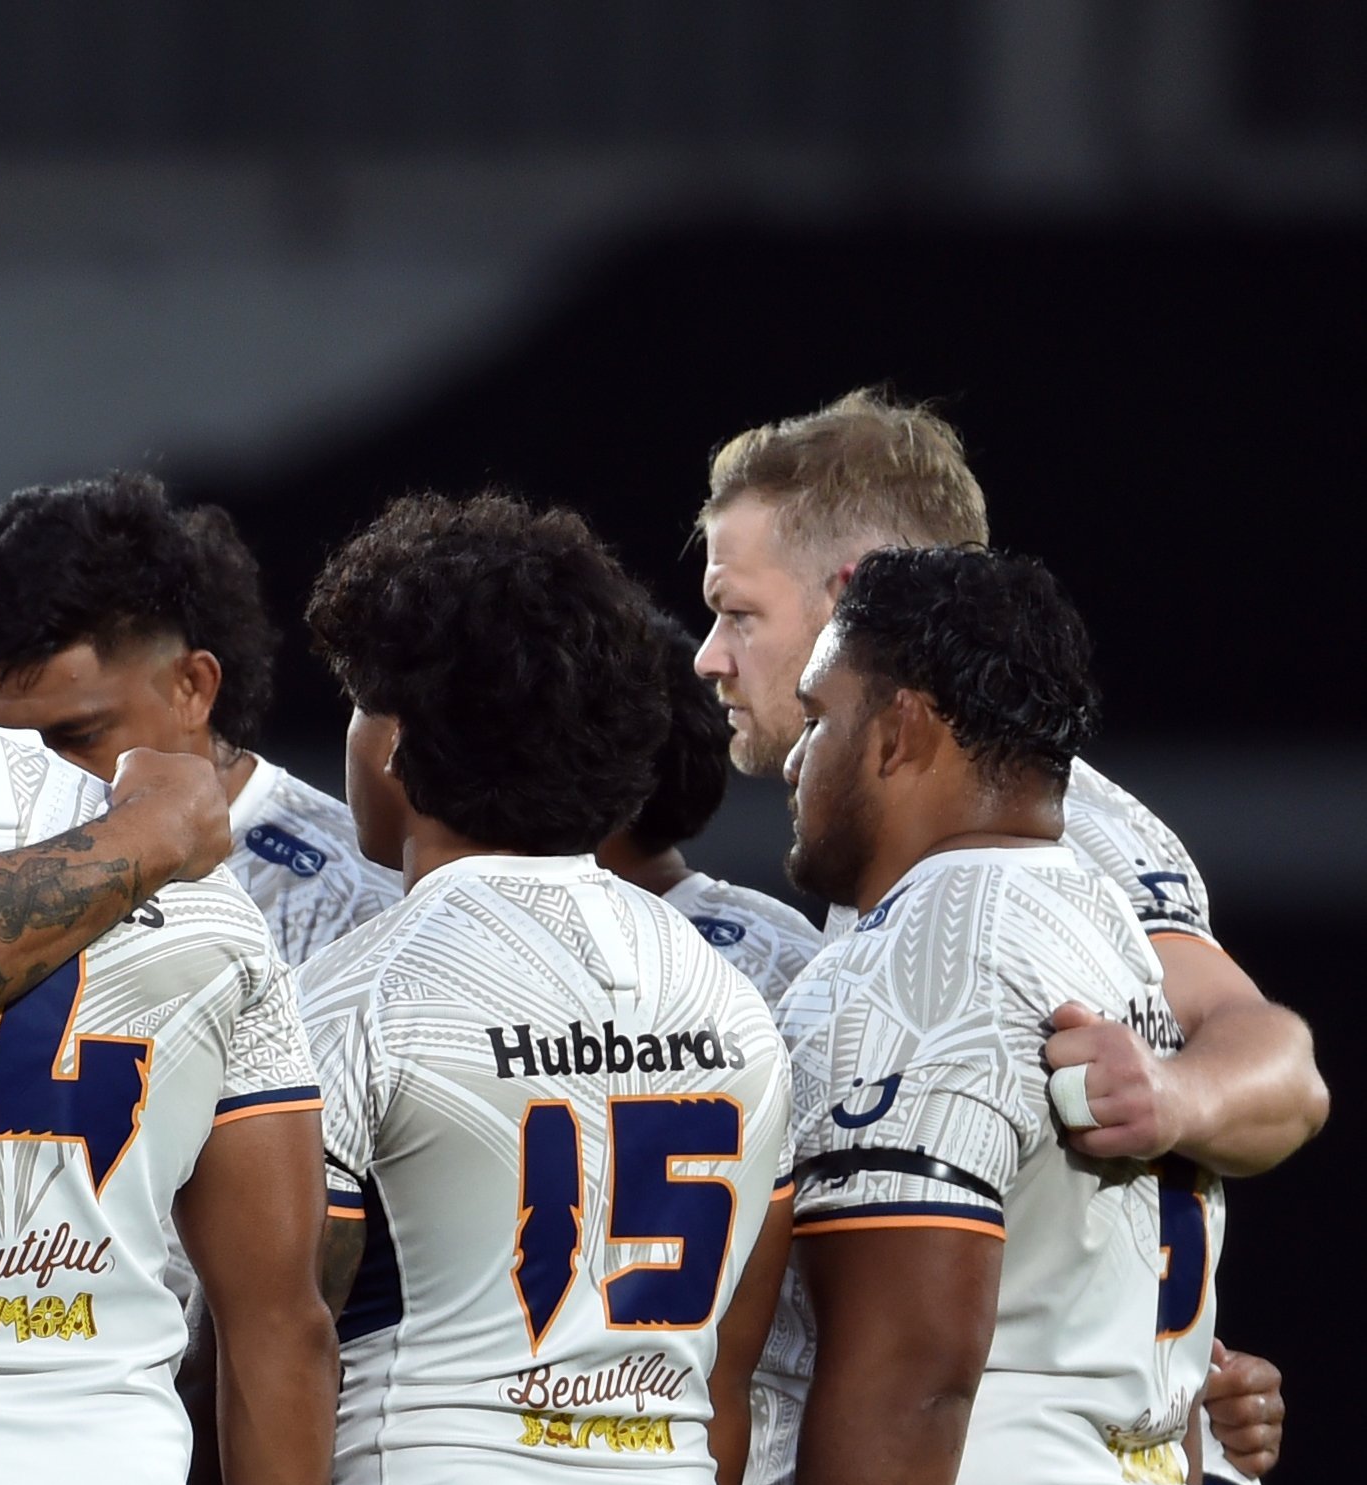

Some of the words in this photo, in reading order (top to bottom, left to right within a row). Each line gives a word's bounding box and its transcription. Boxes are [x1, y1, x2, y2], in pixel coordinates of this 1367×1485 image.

[485, 1017, 747, 1079] Hubbards
[510, 1091, 743, 1358] 15
[506, 1352, 693, 1412] Beautiful
[517, 1409, 676, 1454] SAMOA
